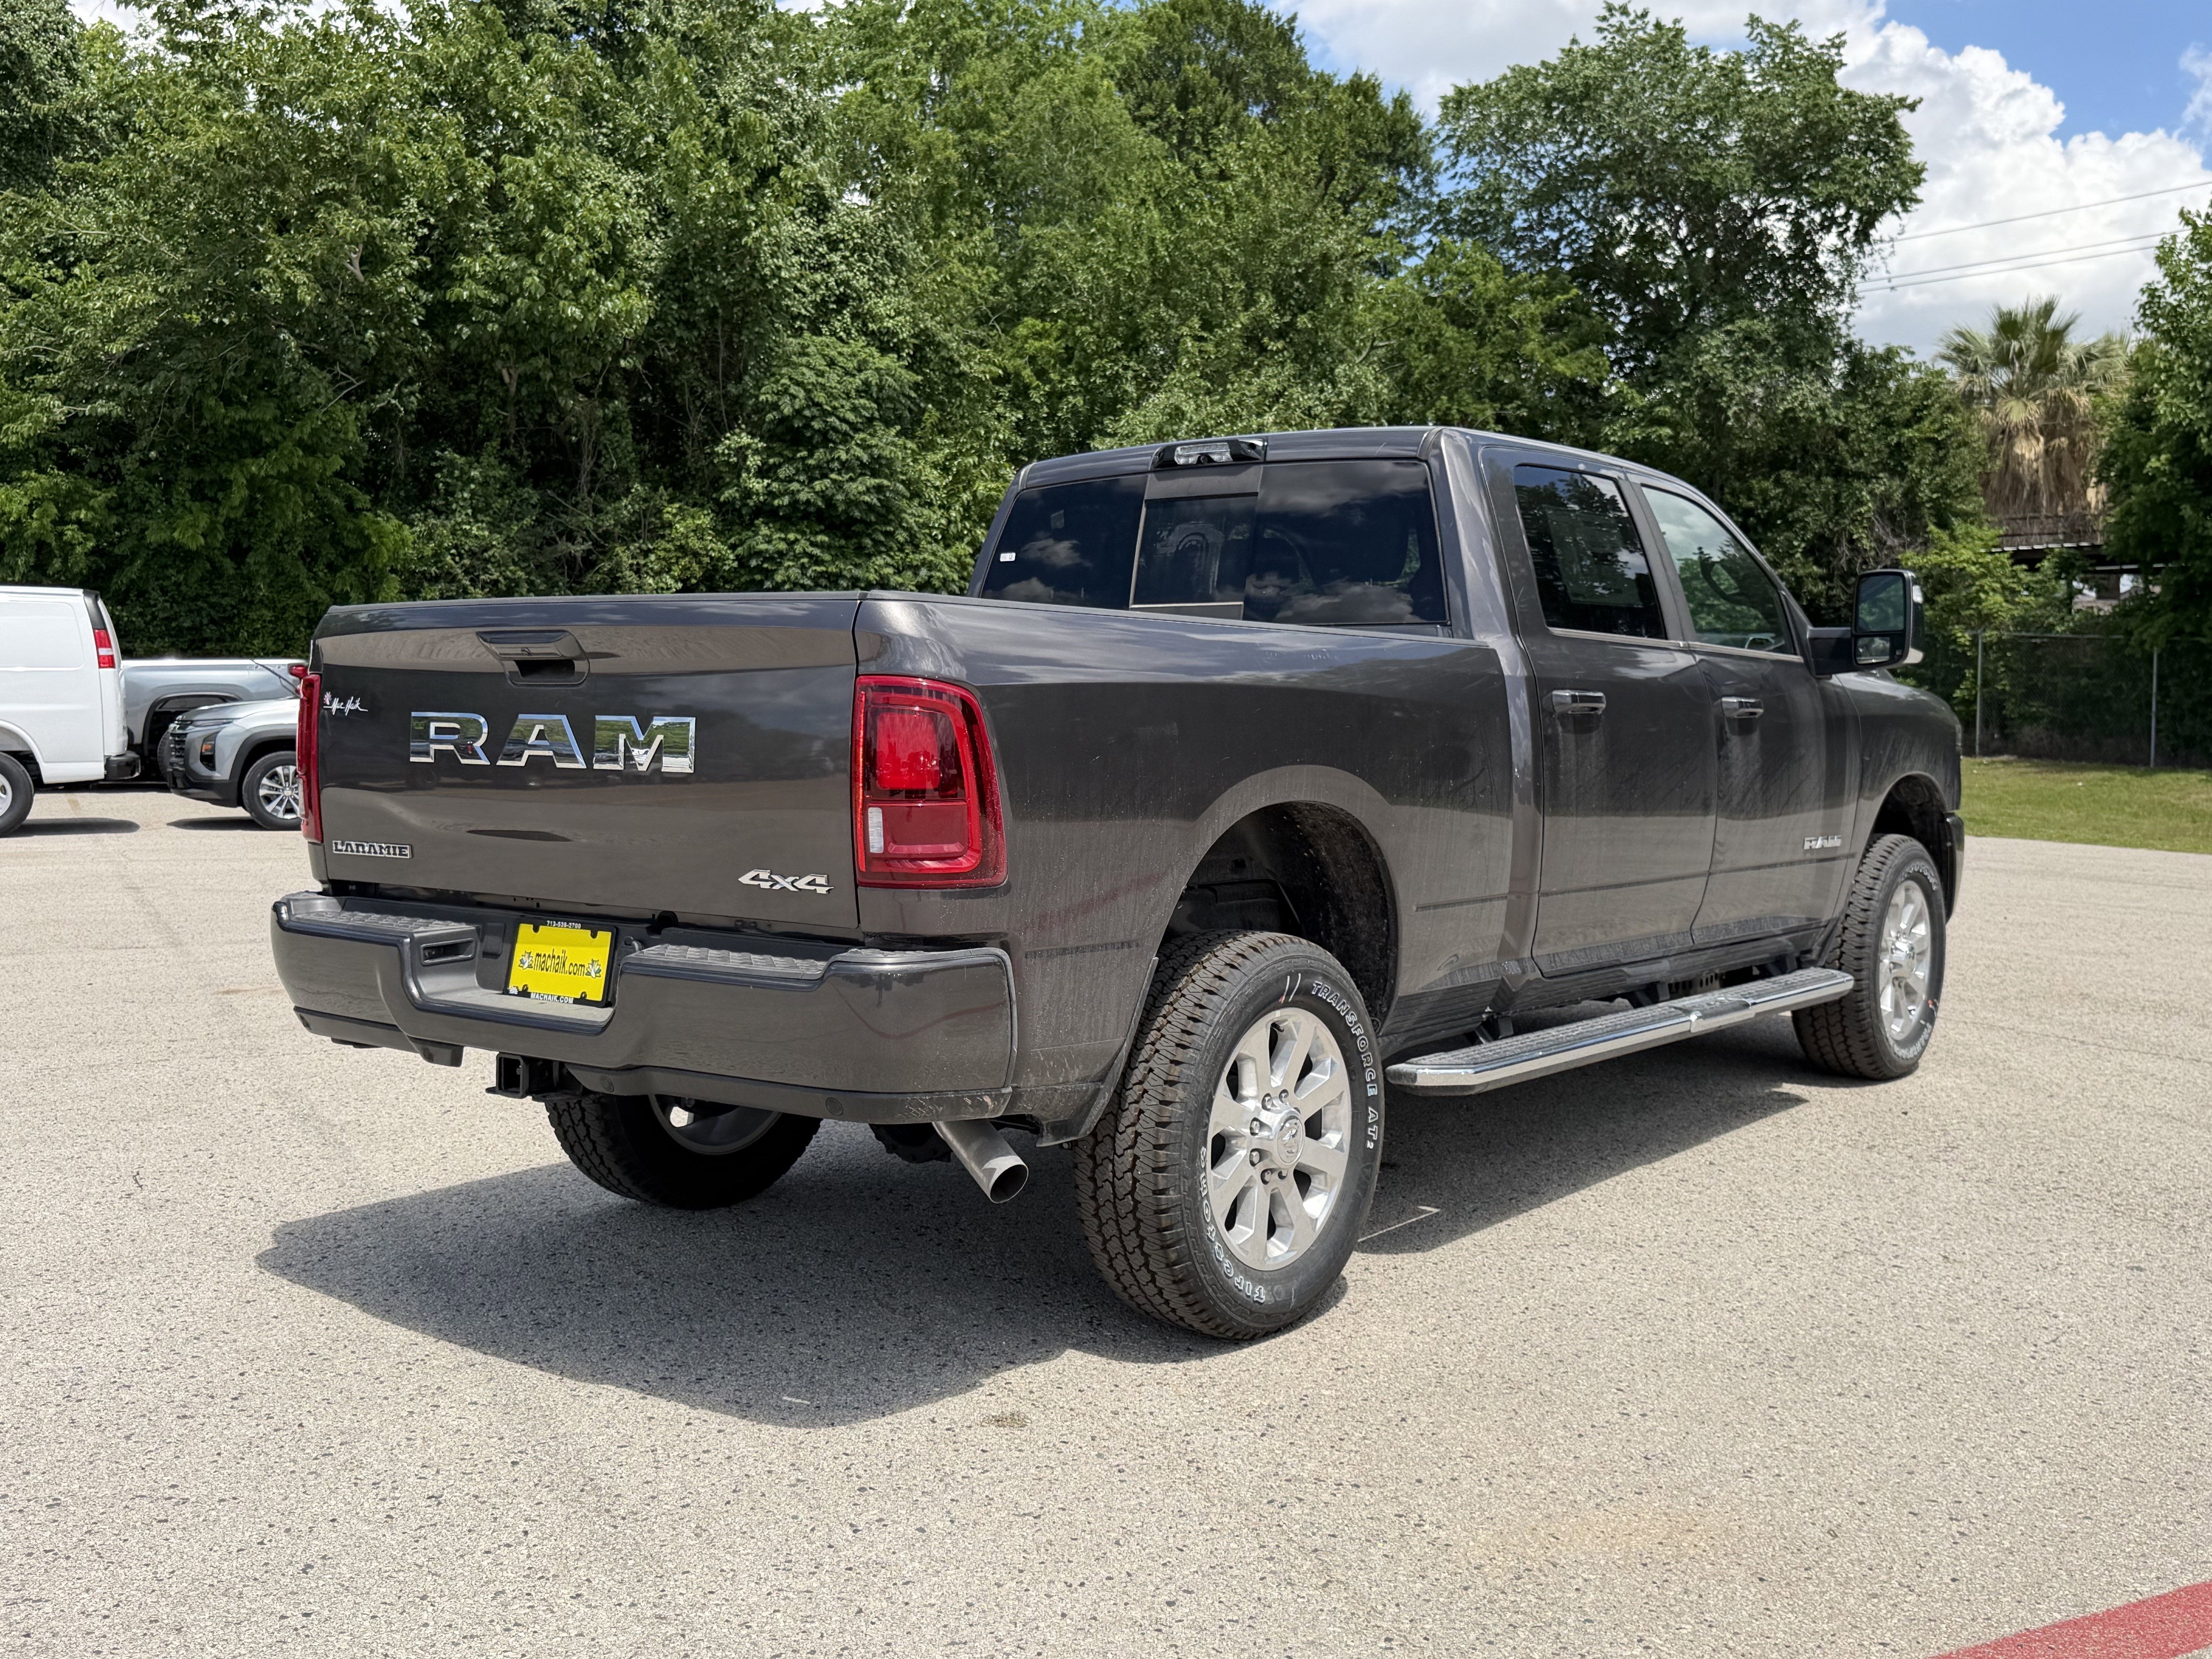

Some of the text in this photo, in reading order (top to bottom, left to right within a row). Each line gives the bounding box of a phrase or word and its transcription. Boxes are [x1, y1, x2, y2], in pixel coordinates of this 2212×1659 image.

[410, 711, 696, 773] RAM
[332, 840, 412, 858] LARAMIE
[533, 948, 586, 977] machaik.com
[531, 992, 574, 1004] MACHAIK.COM
[1311, 980, 1377, 1096] TRANSFORCE
